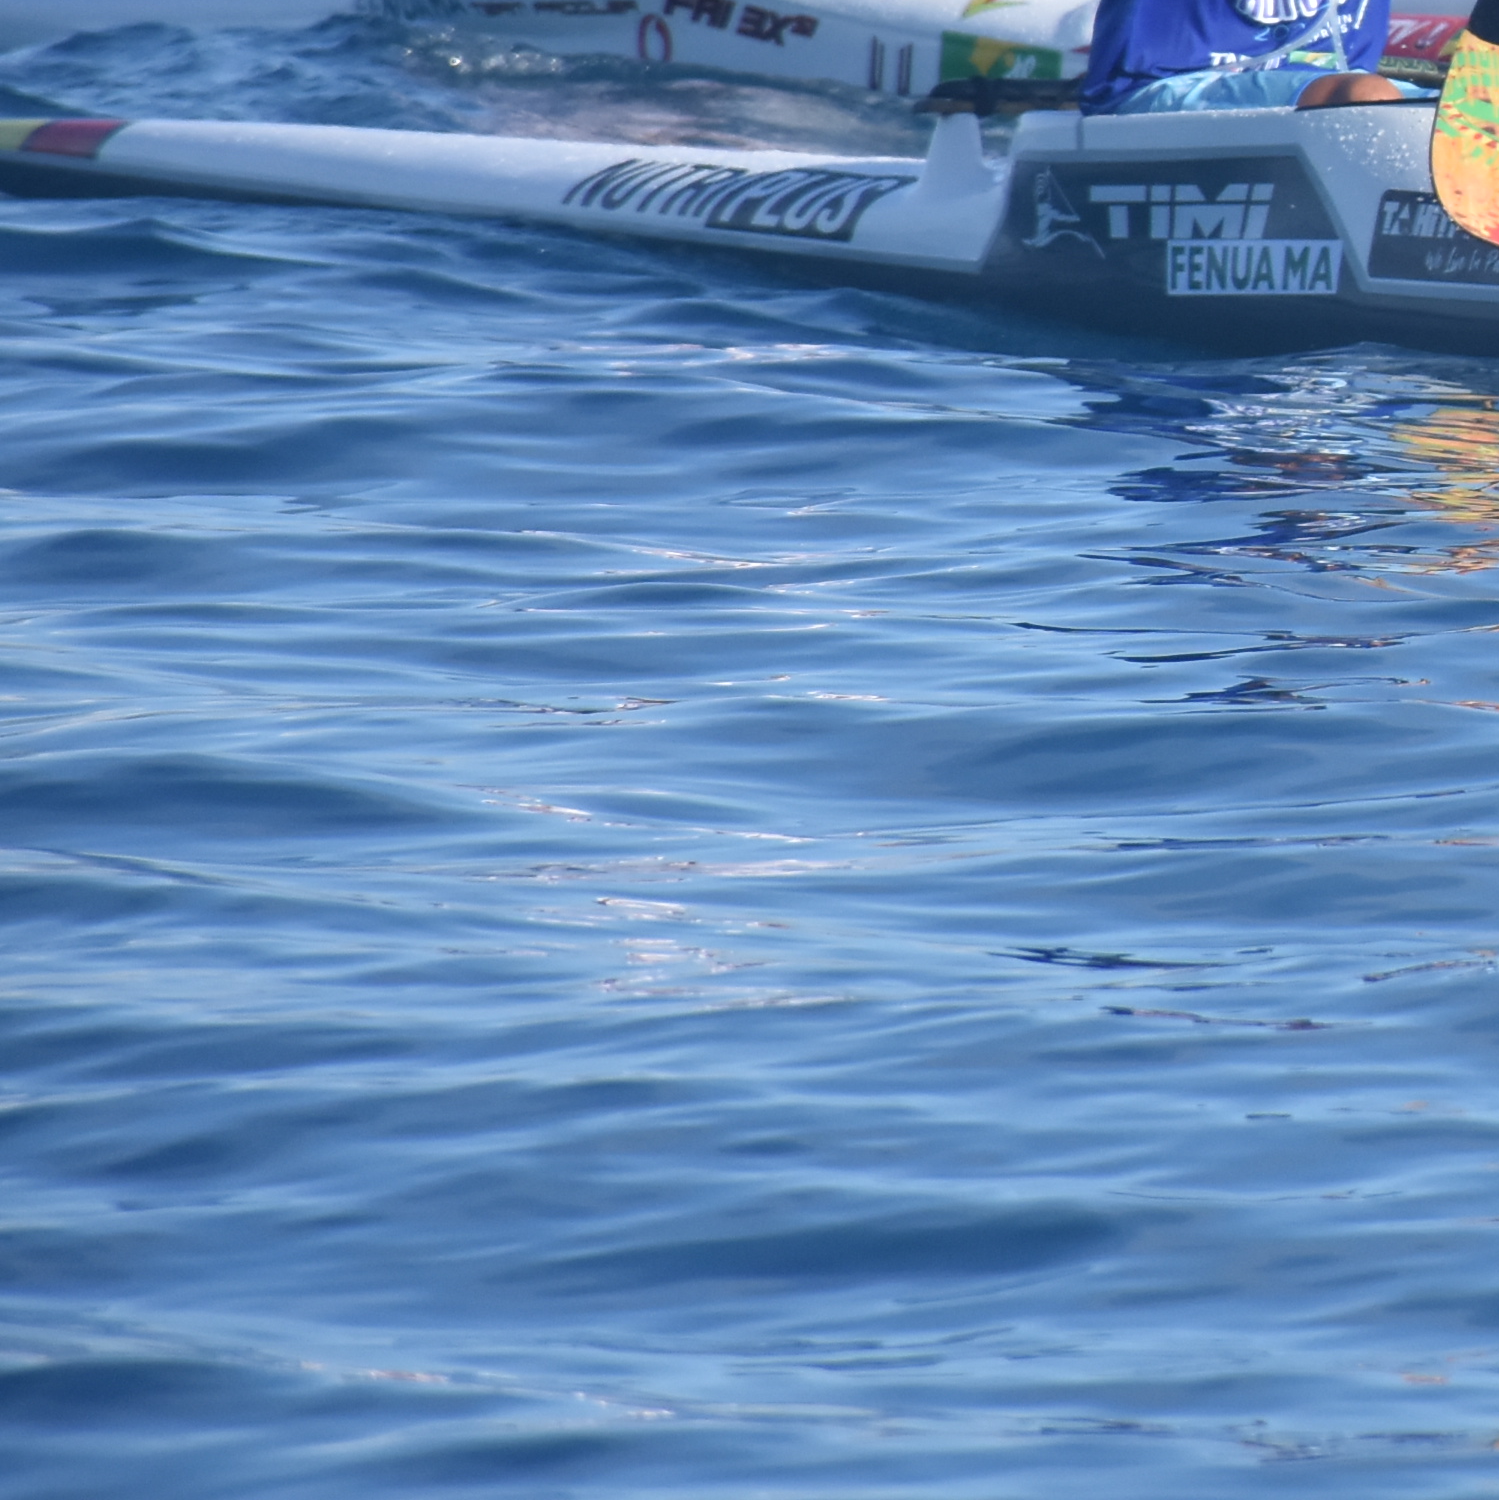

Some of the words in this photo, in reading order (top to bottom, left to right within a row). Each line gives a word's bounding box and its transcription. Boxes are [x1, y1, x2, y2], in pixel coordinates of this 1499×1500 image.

[1088, 183, 1275, 240] TIMI
[1170, 244, 1275, 292] FENUA
[1279, 244, 1335, 292] MA
